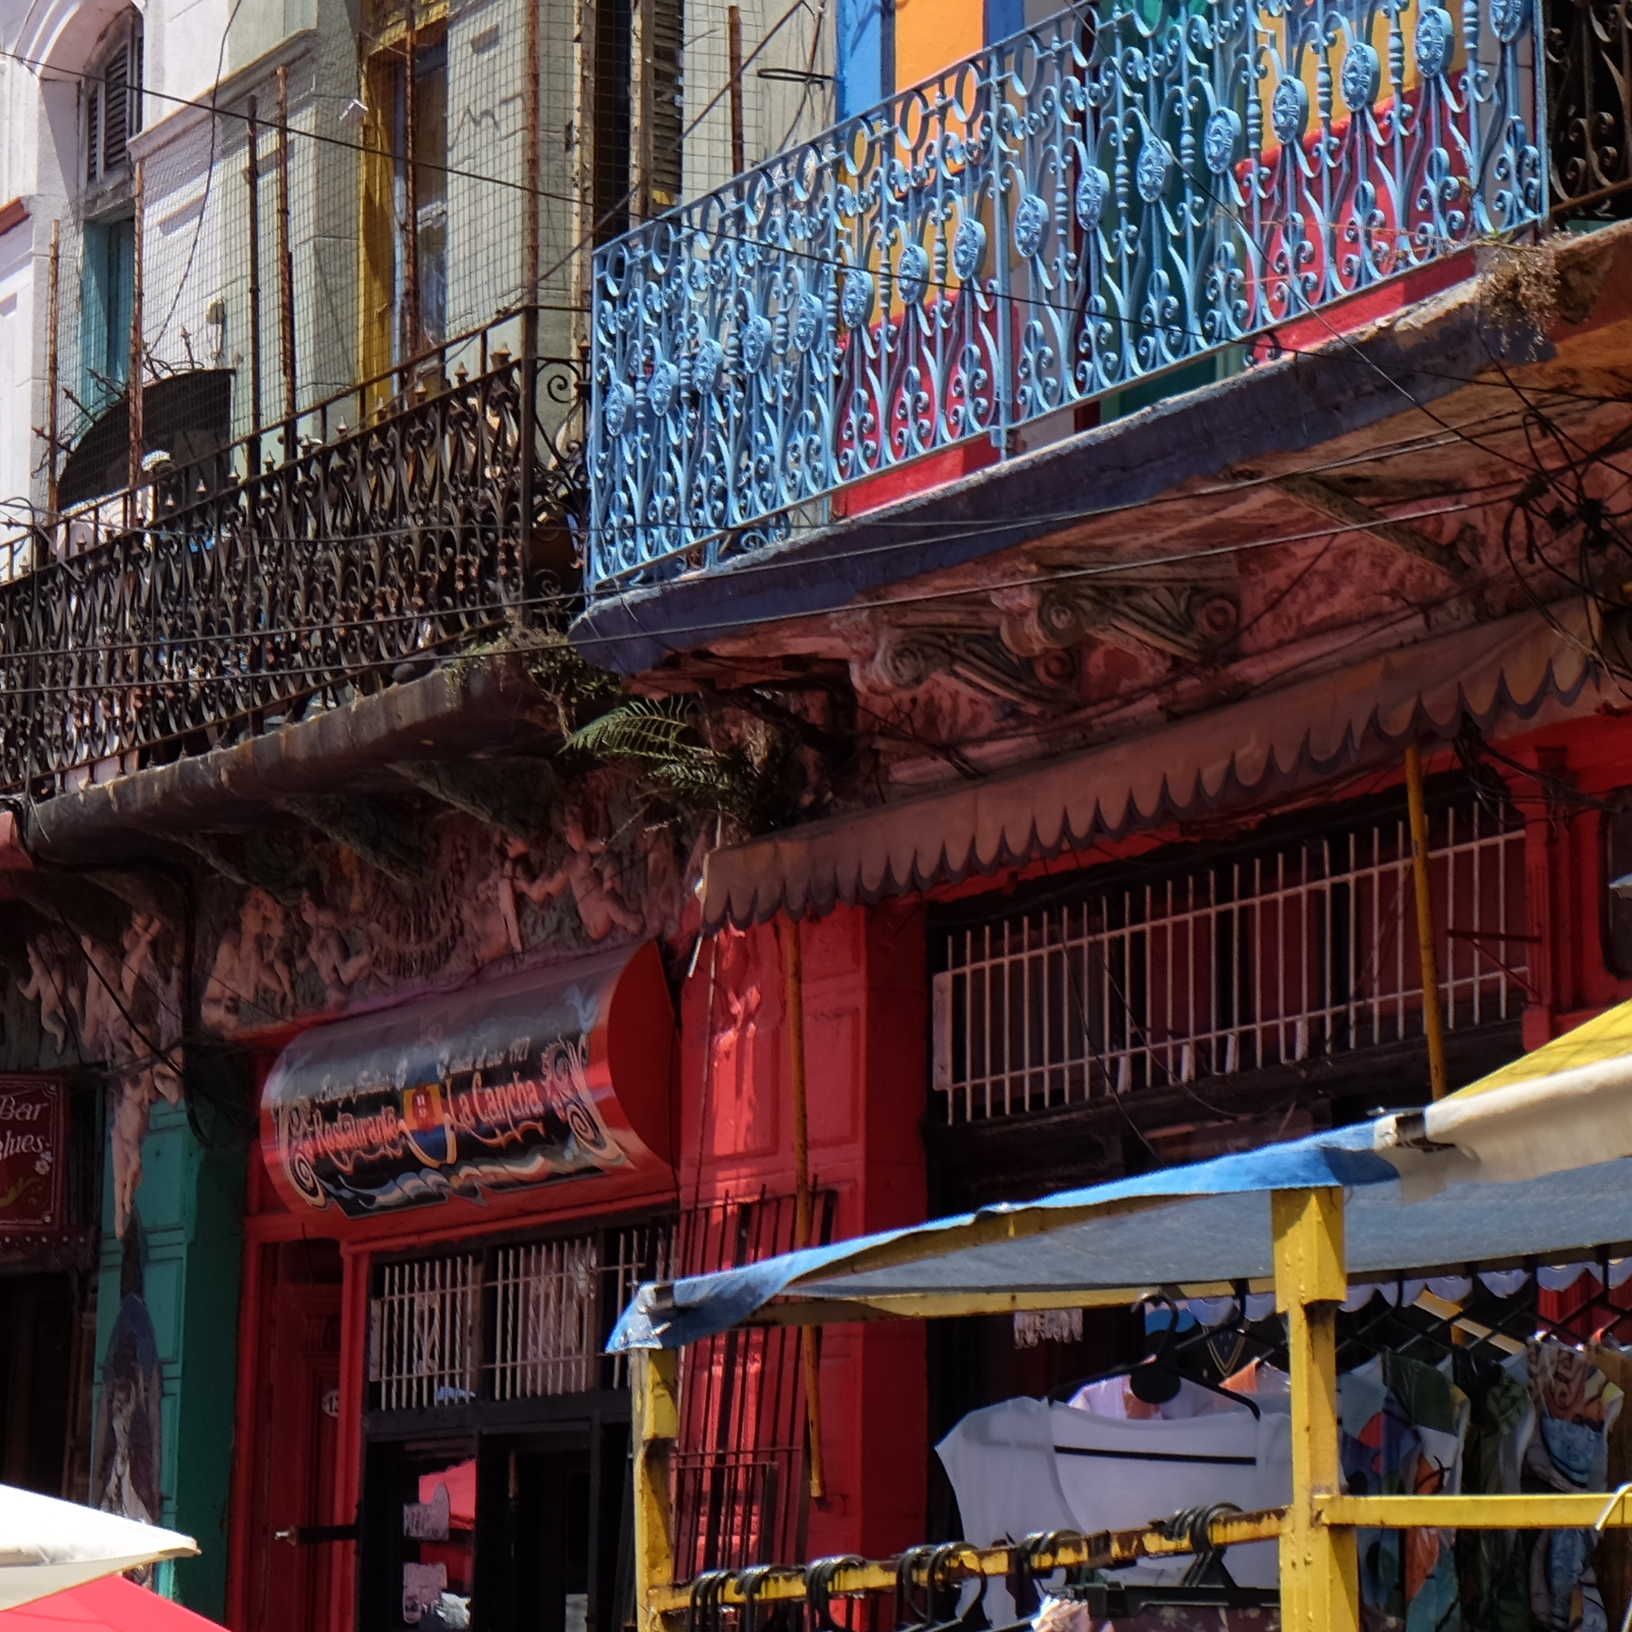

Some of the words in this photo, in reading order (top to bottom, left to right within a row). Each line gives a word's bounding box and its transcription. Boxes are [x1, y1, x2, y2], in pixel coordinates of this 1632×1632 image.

[509, 1036, 531, 1064] 1927
[446, 1078, 477, 1128] La
[472, 1071, 544, 1131] Cancha
